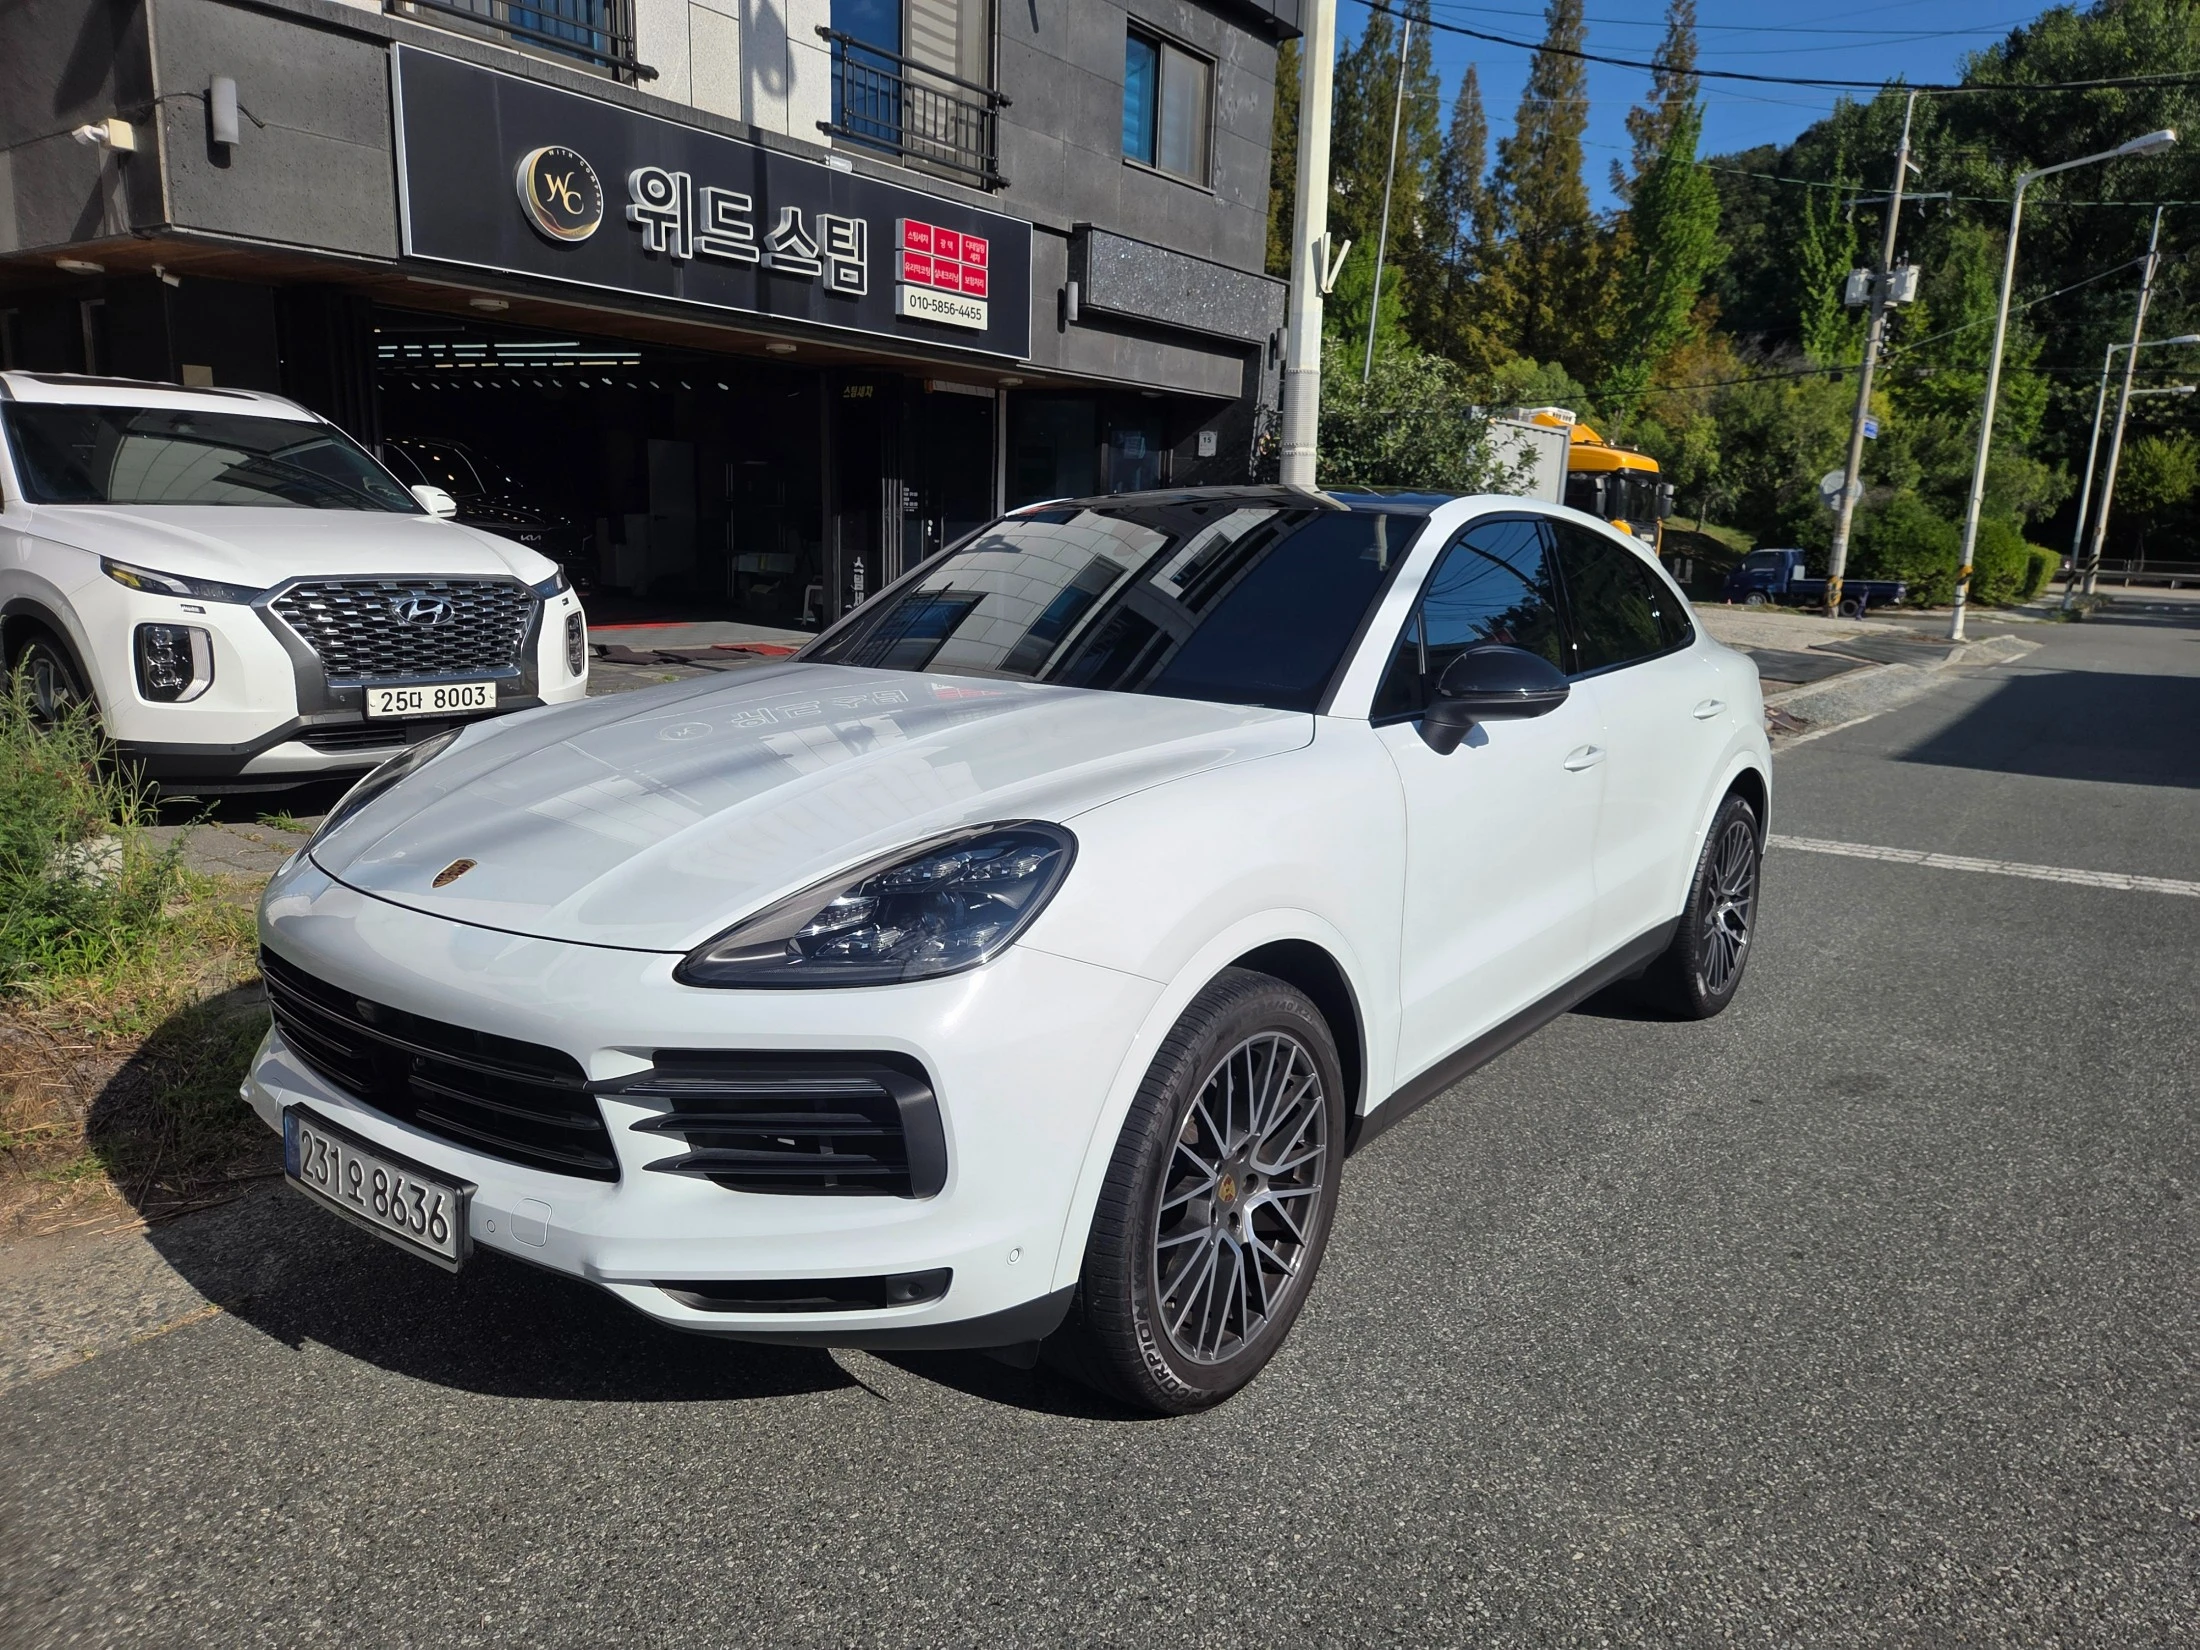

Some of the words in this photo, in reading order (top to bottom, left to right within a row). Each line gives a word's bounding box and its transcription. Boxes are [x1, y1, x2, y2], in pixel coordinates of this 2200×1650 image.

[626, 166, 868, 296] 위드스팀
[907, 230, 929, 244] 스팀세차
[904, 262, 931, 277] 유리막코팅
[909, 294, 982, 320] 010-5856-4455
[381, 691, 423, 713] 25다
[434, 686, 486, 708] 8003
[372, 1166, 451, 1244] 8636
[1134, 1299, 1203, 1406] SCORPION
